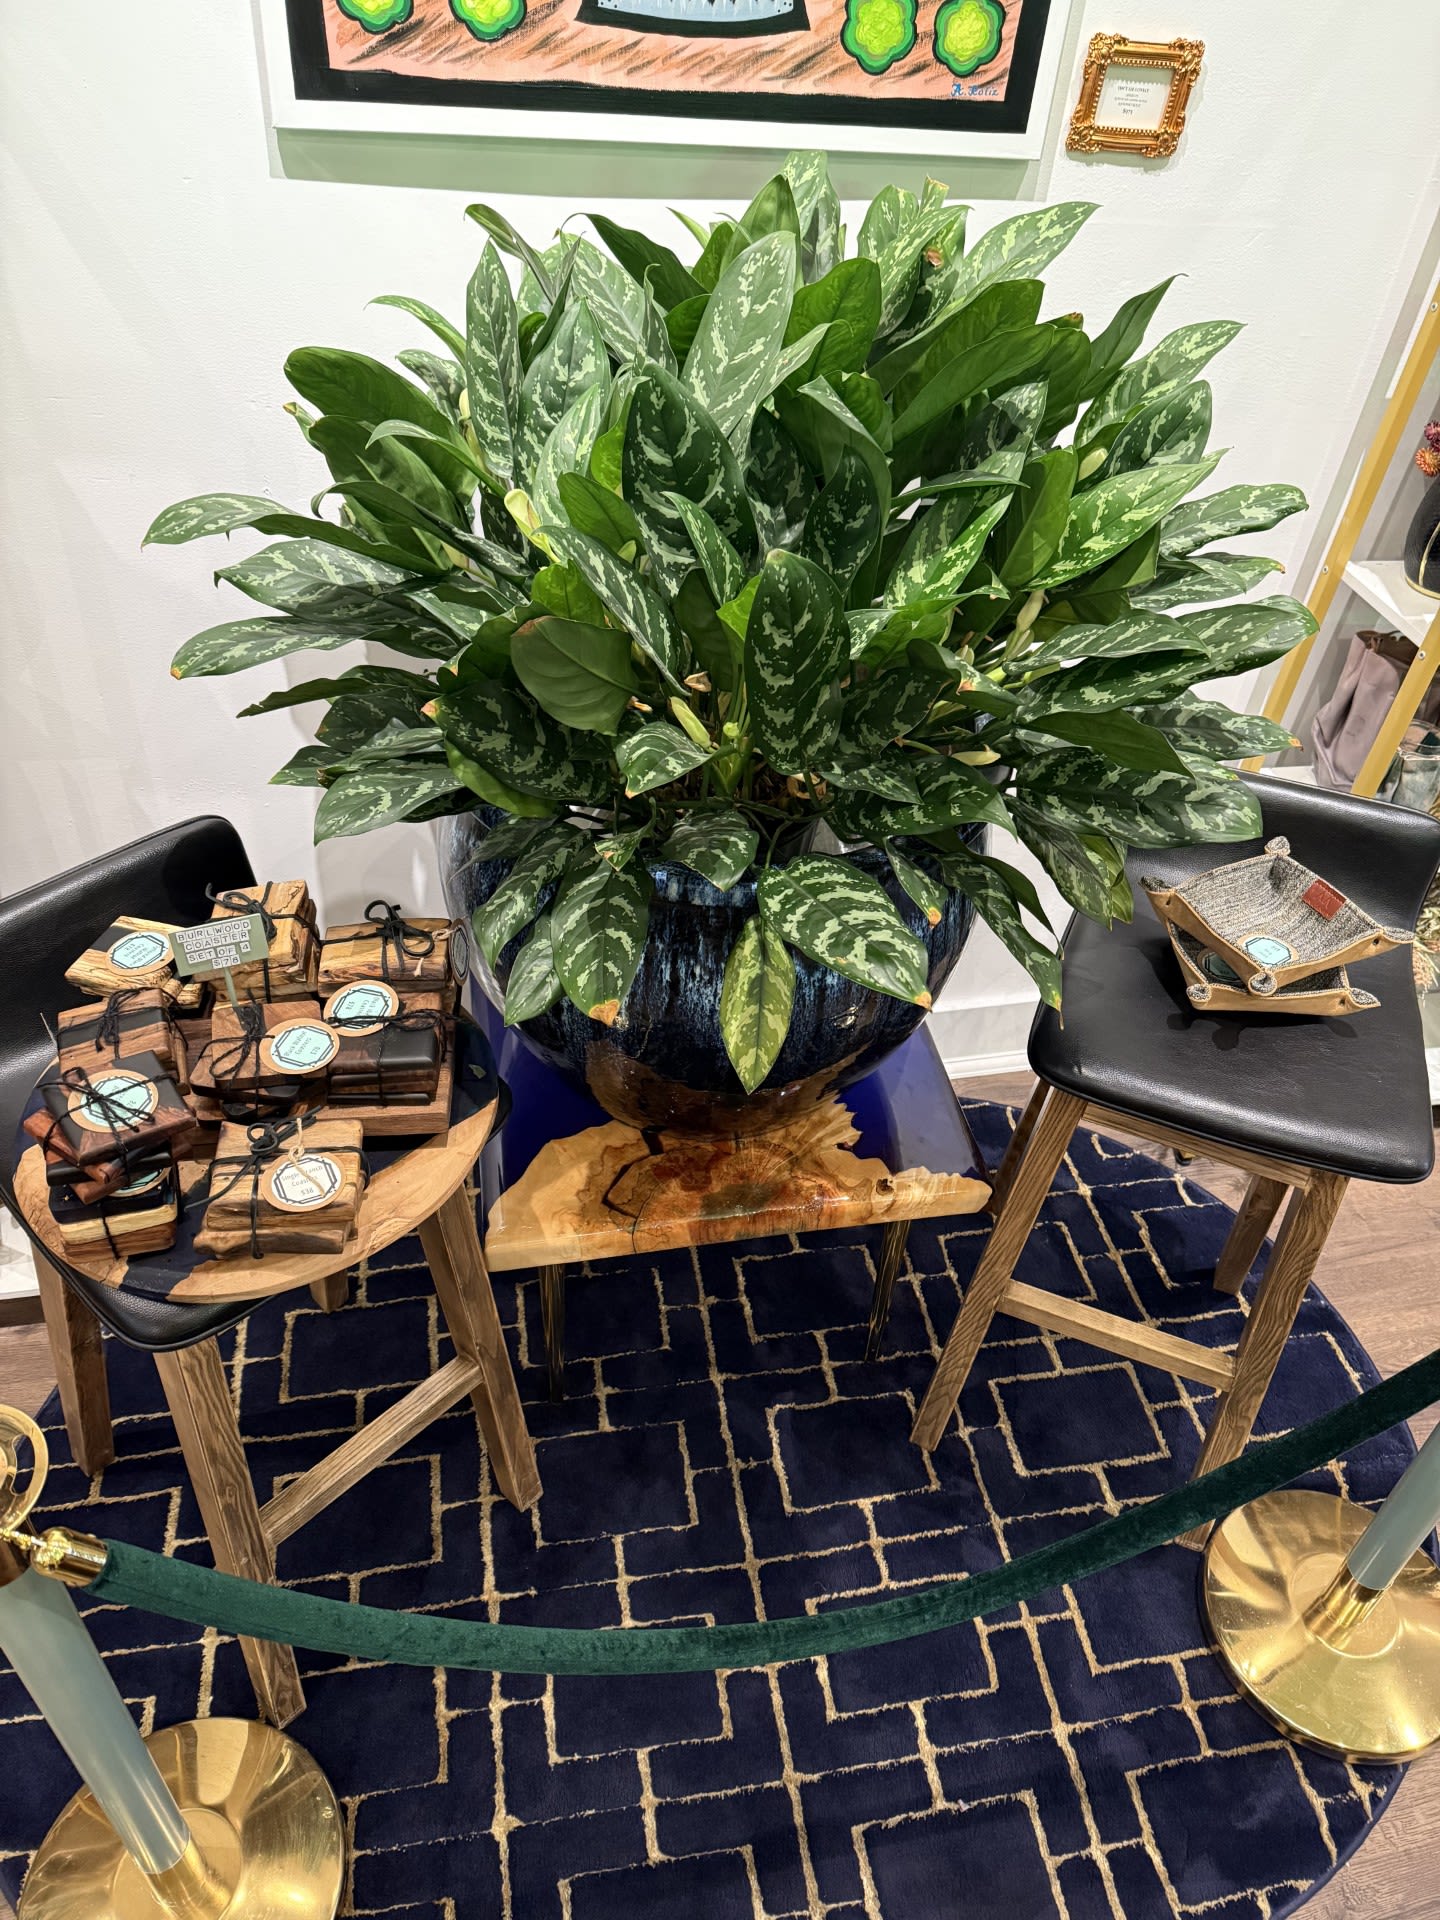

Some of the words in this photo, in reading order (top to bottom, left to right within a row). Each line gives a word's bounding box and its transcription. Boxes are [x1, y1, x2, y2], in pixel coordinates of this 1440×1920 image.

[177, 921, 250, 941] BURLWOOD
[185, 932, 248, 951] COASTER
[188, 950, 213, 962] SET
[218, 947, 234, 956] OF
[213, 957, 240, 967] $78
